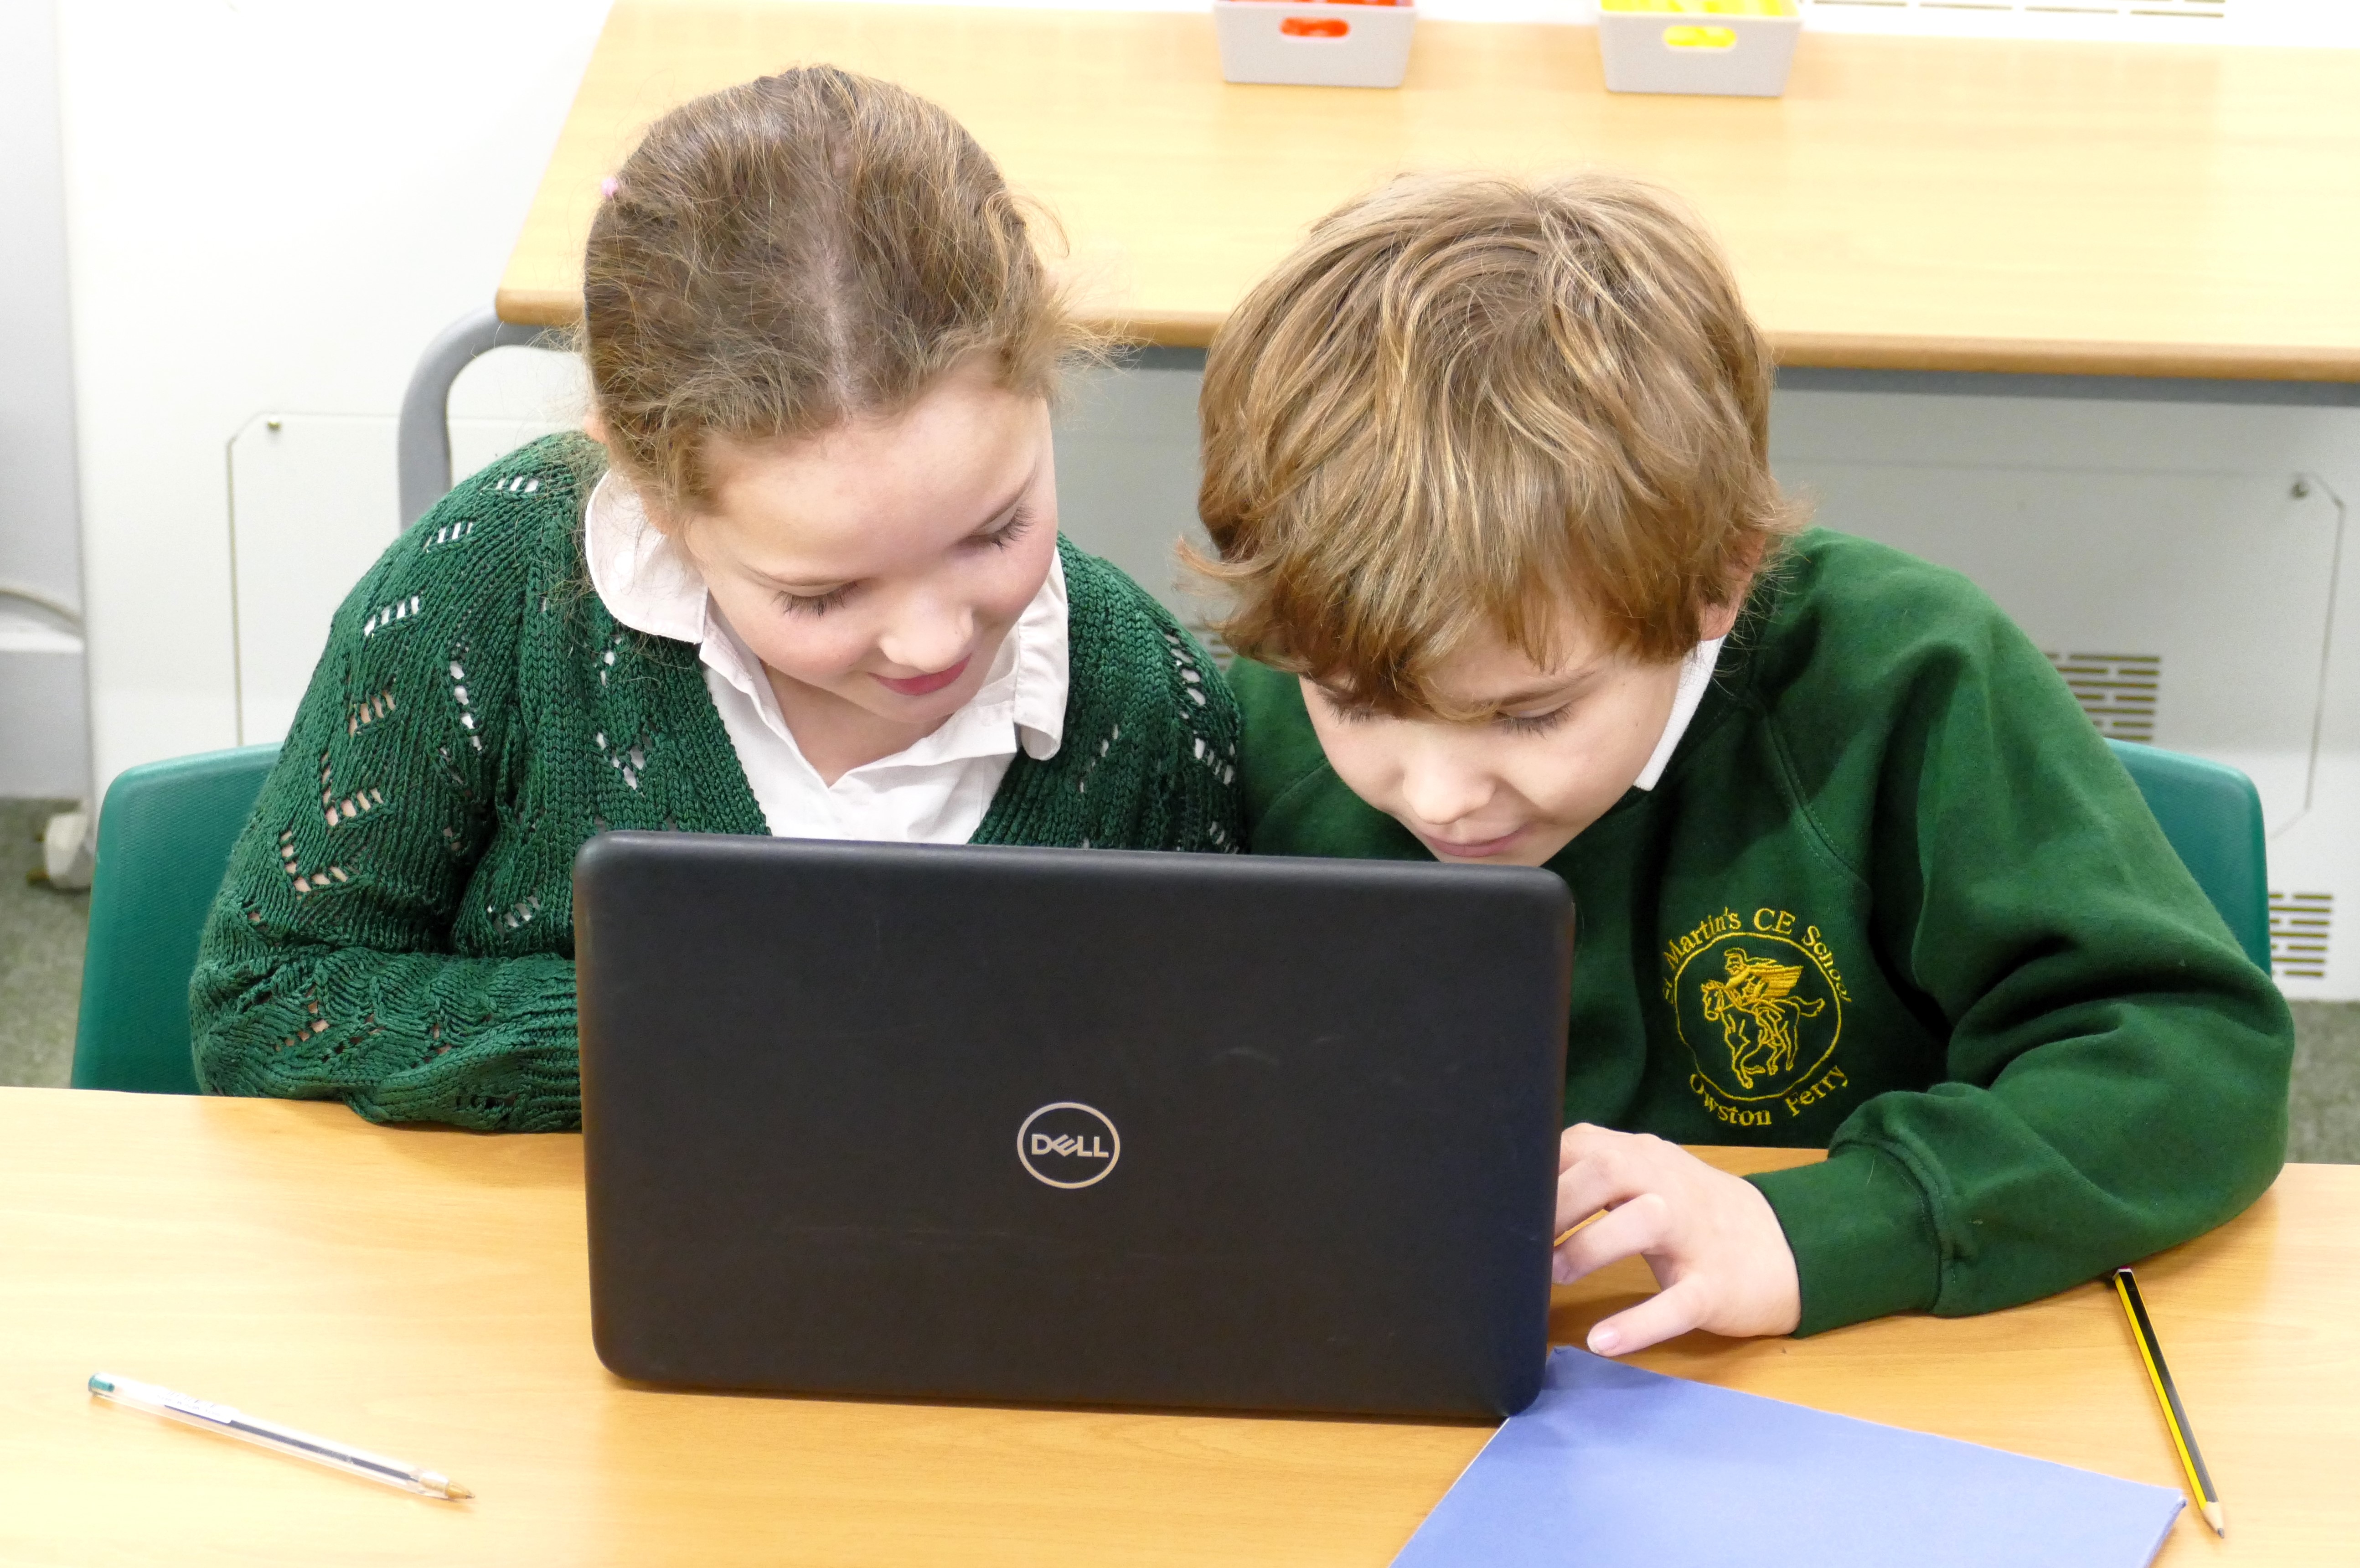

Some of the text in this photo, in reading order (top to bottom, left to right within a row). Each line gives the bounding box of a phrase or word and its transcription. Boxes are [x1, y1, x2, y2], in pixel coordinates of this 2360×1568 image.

[1663, 907, 1741, 970] Martin's
[1754, 908, 1796, 935] CE
[1689, 1065, 1849, 1126] Owston Ferry
[1031, 1133, 1109, 1158] DELL
